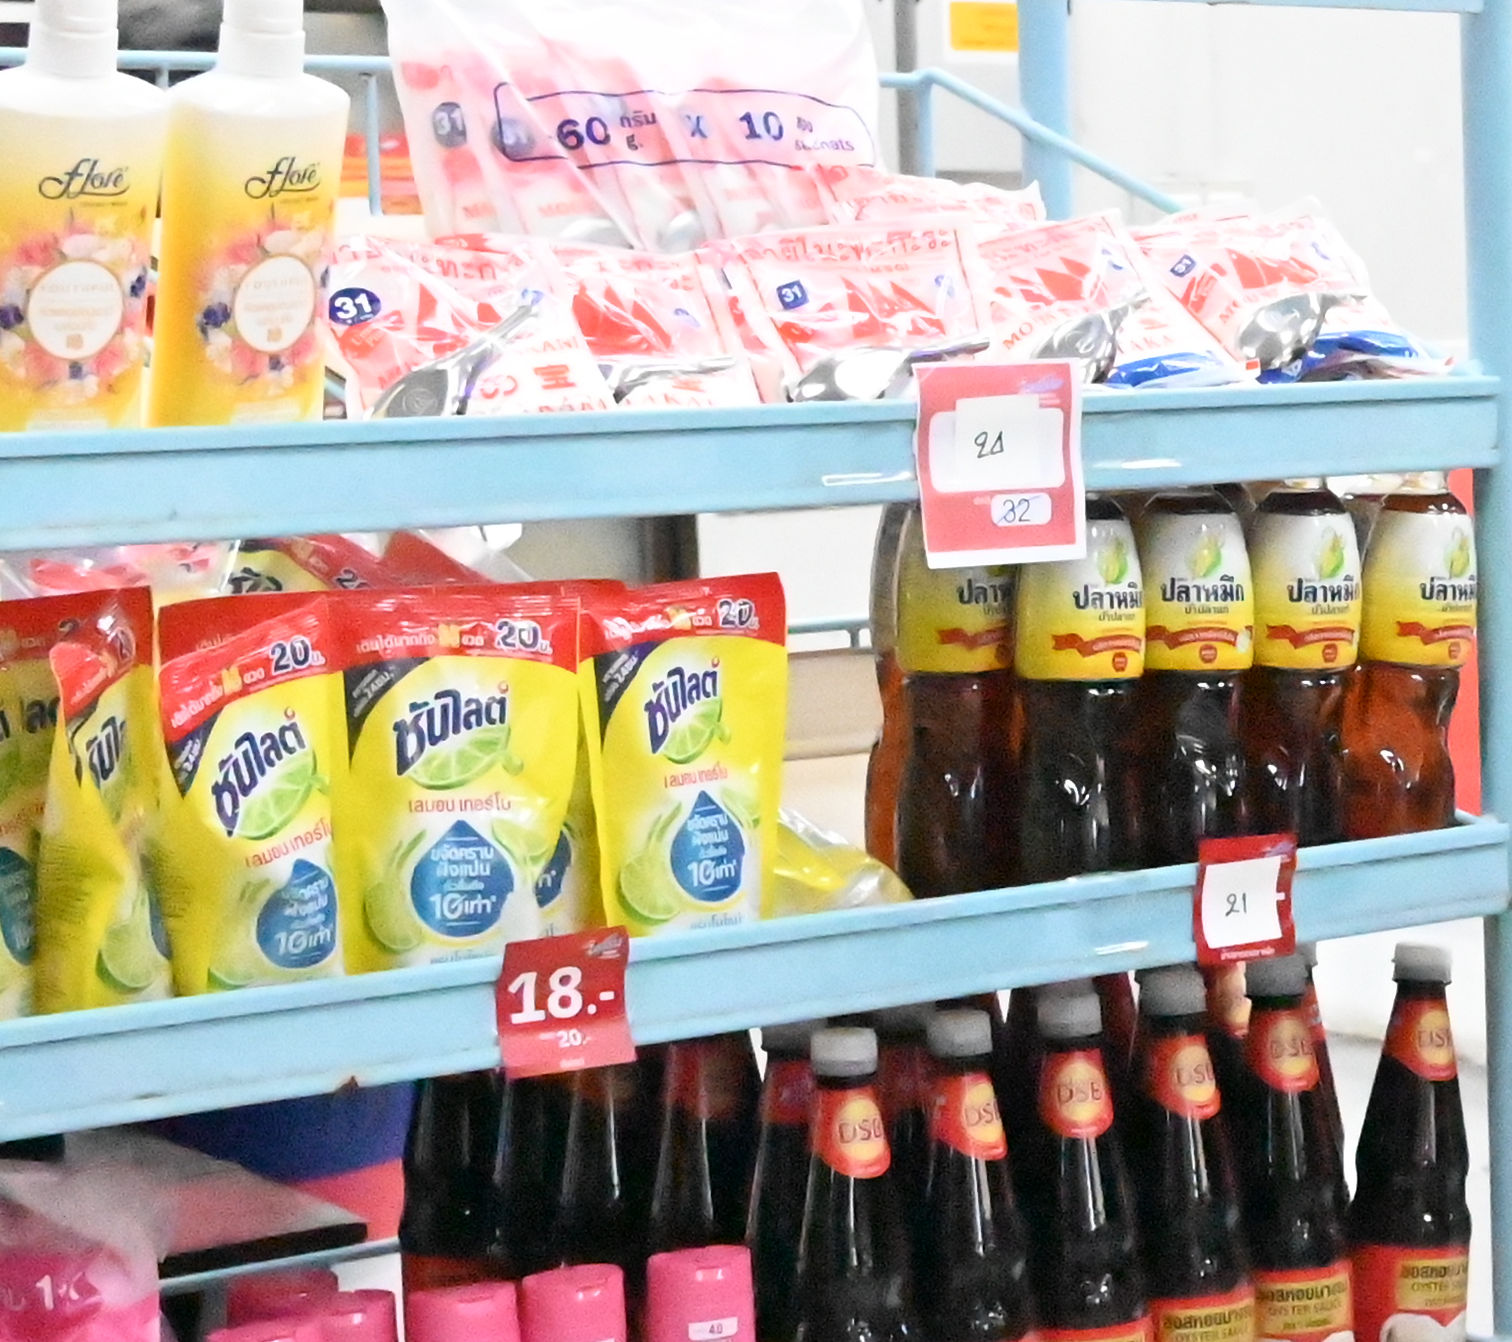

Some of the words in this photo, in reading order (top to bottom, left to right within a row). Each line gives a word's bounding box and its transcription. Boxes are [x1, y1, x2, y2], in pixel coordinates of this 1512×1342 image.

[557, 115, 611, 150] 60
[743, 111, 784, 141] 10
[333, 292, 372, 320] 31
[780, 284, 803, 302] 31
[1072, 581, 1144, 610] ปลาหมึ
[643, 655, 721, 755] ซันไลต์
[392, 680, 510, 776] ซันไลต์
[210, 705, 307, 838] ซันไลต์
[1225, 892, 1247, 917] 21
